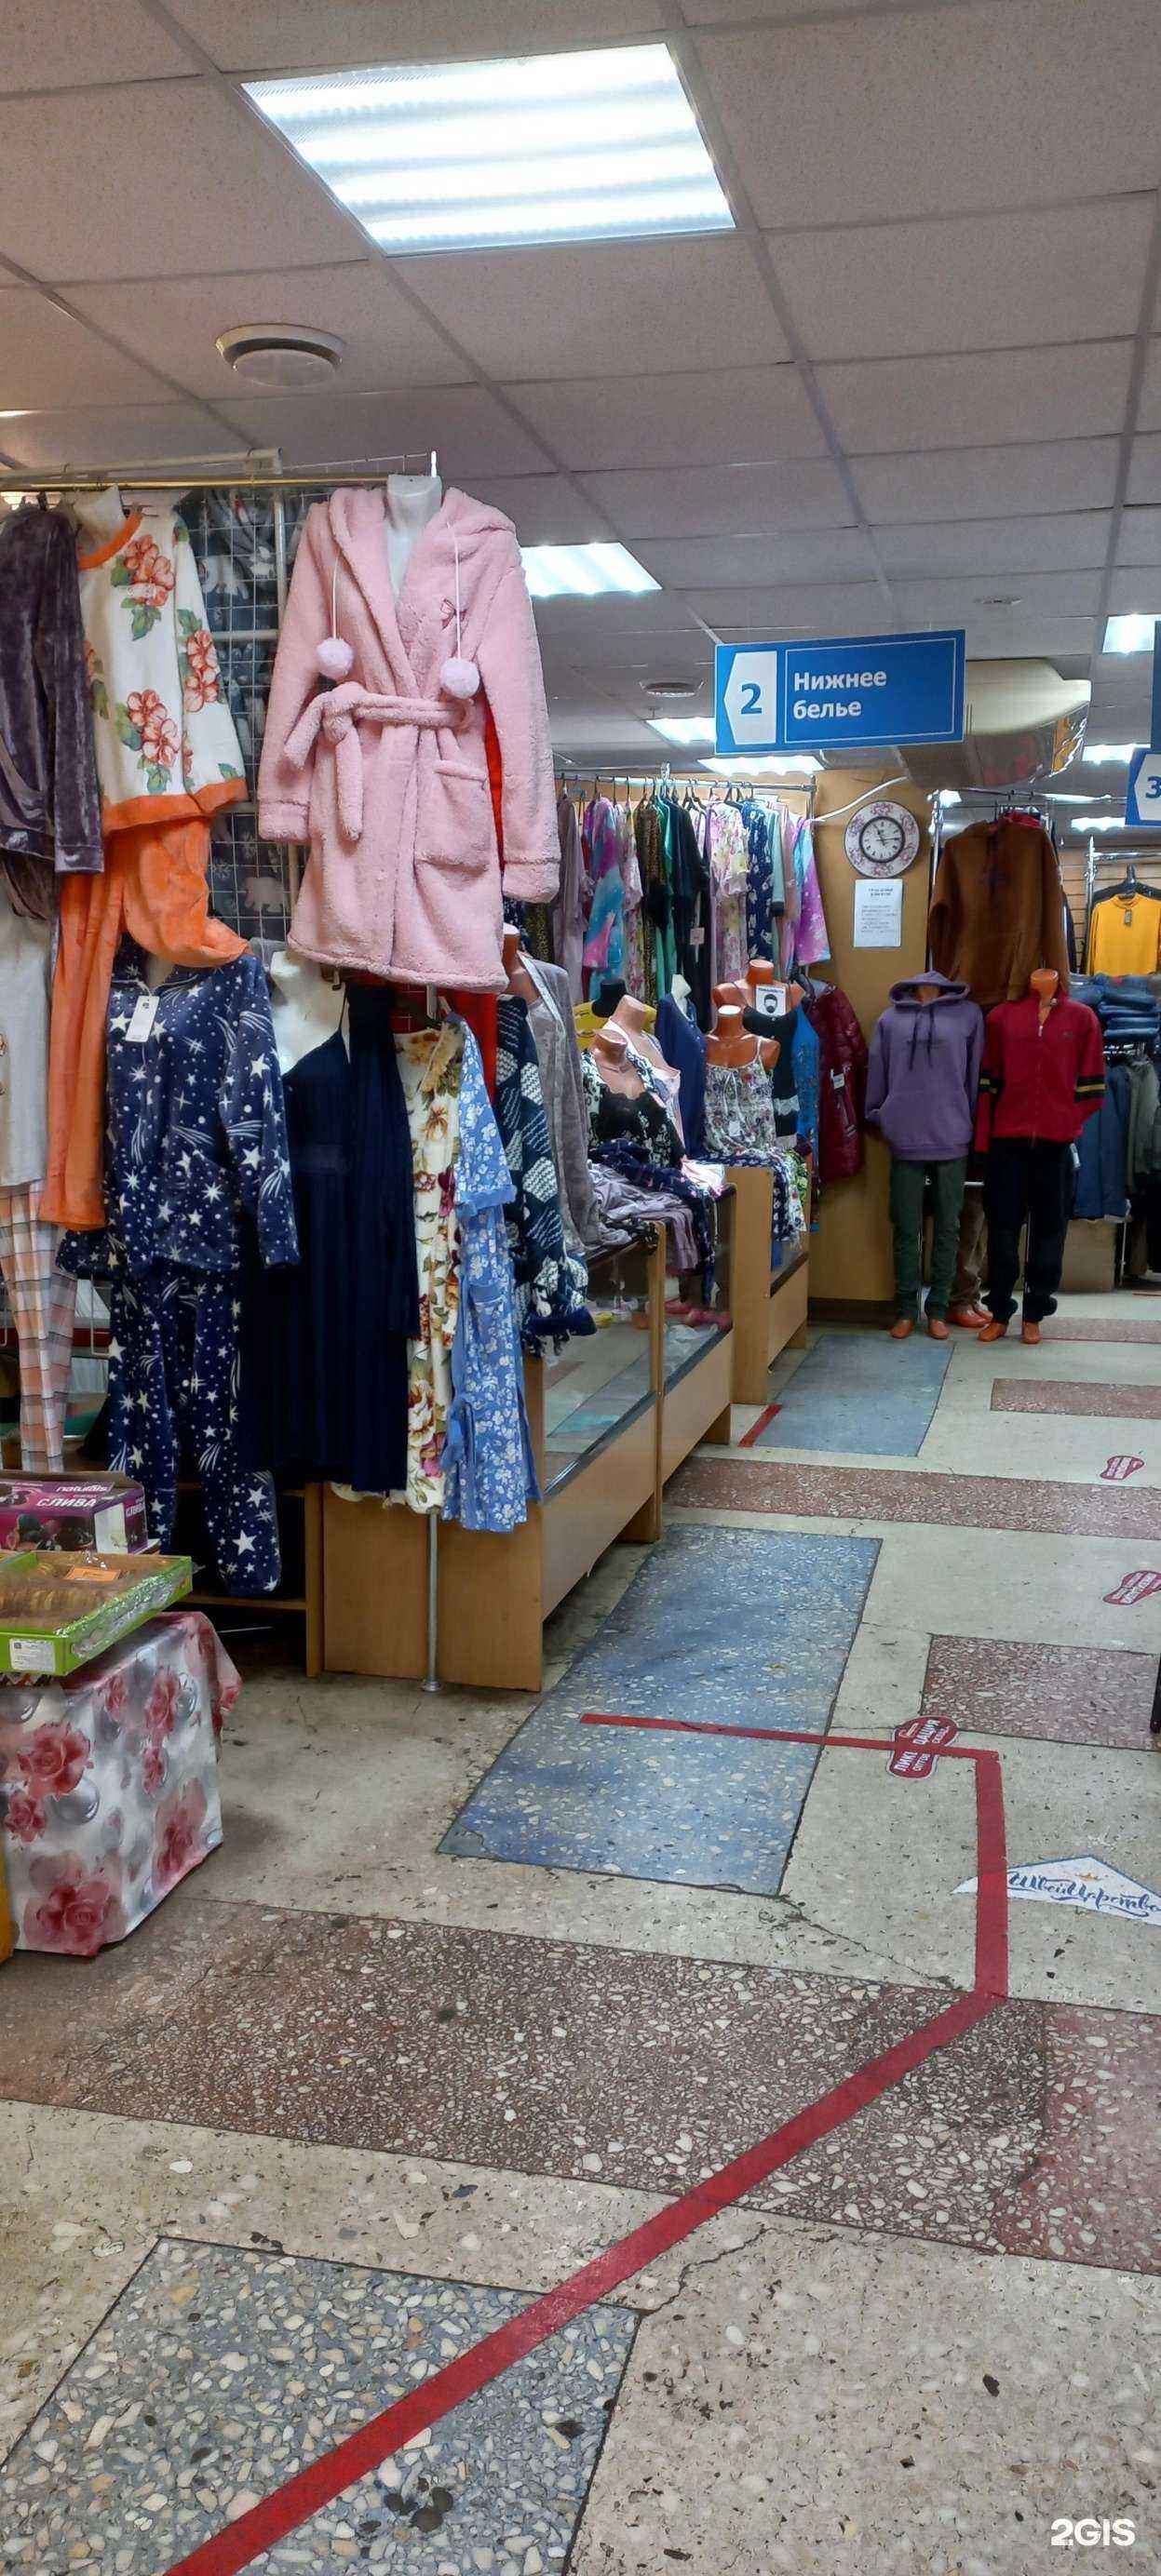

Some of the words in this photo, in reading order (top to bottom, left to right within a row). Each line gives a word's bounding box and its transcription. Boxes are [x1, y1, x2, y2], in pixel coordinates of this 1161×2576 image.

[794, 670, 887, 692] Нижнее
[740, 683, 763, 715] 2
[793, 700, 862, 719] белье
[1145, 775, 1161, 798] 3
[36, 1497, 97, 1508] СЛИВА
